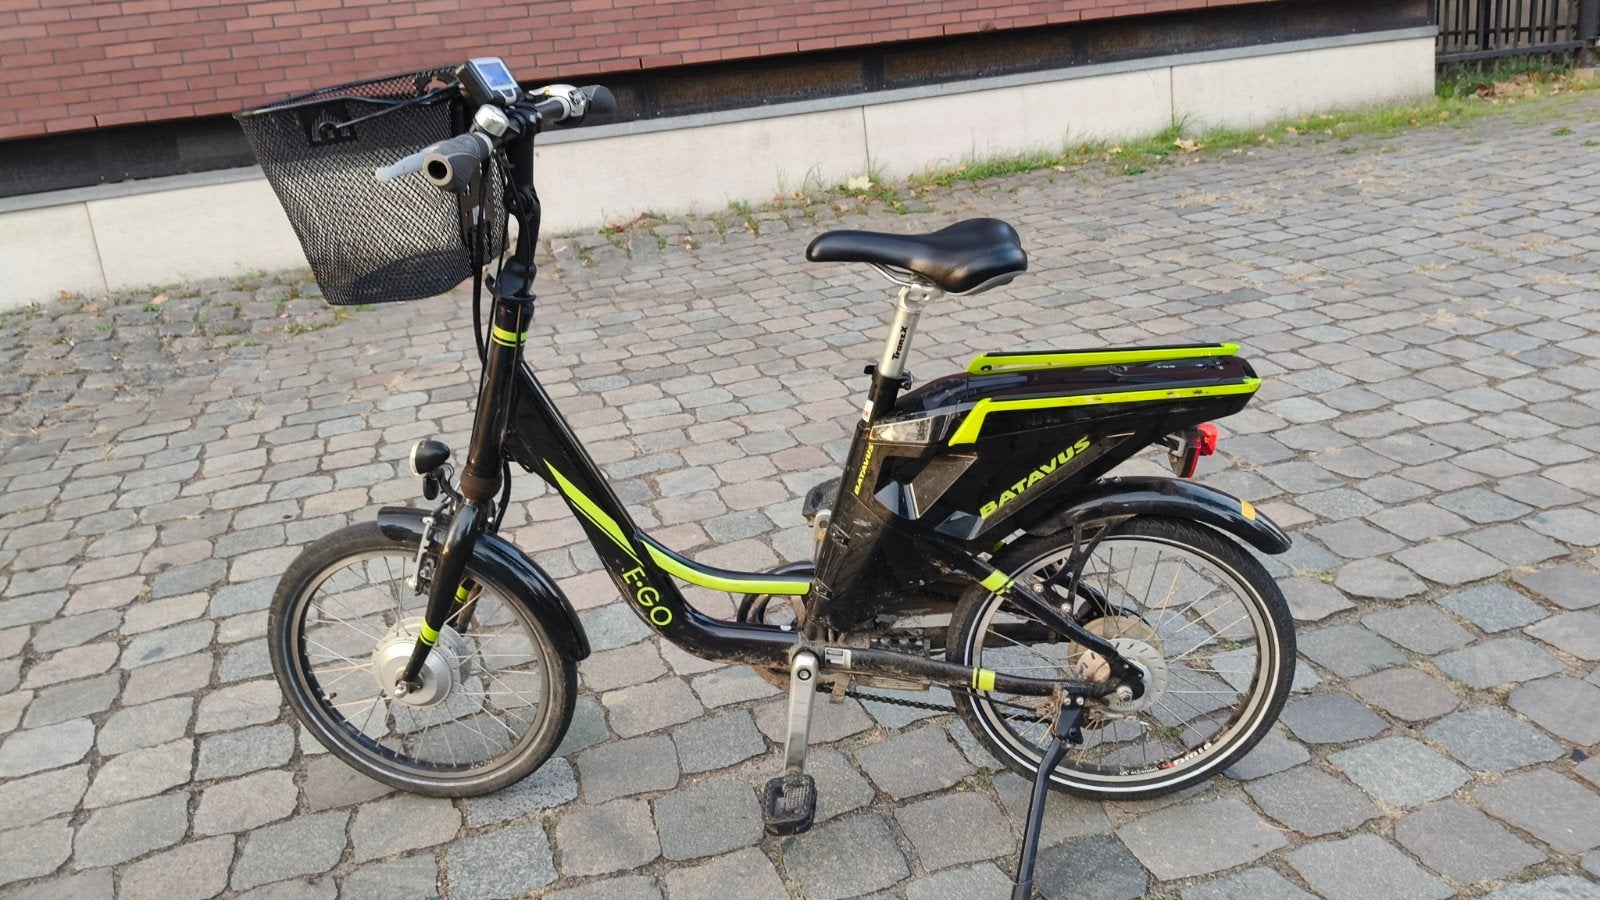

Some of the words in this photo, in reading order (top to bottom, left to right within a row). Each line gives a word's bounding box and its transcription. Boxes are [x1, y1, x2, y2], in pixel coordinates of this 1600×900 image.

[891, 325, 909, 360] TranzX
[854, 443, 874, 496] BATAVUS
[979, 435, 1091, 520] BATAVUS
